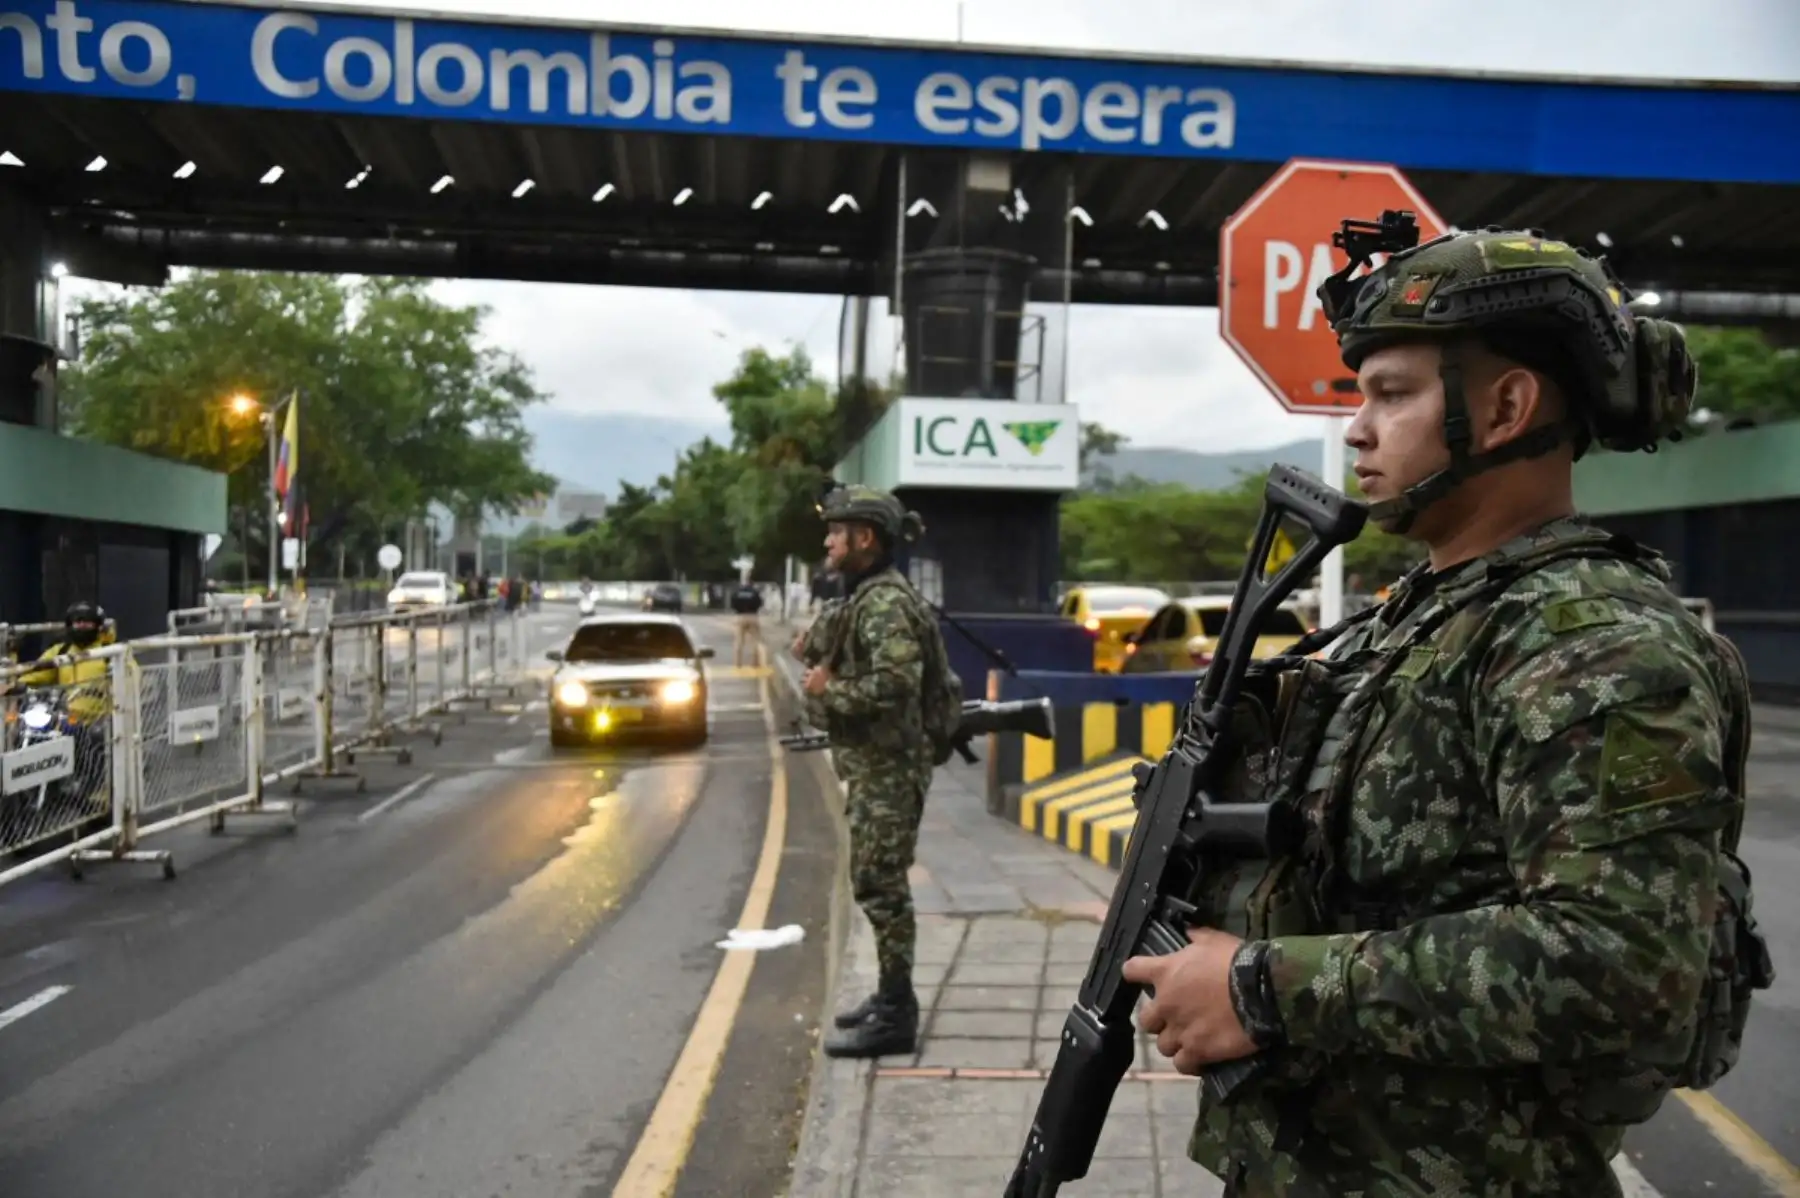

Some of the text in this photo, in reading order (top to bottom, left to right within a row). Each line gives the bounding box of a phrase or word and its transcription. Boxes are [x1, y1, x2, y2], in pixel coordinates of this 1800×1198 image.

[251, 12, 732, 124] Colombia
[777, 51, 878, 130] te
[915, 72, 1235, 151] espera
[914, 416, 998, 457] ICA
